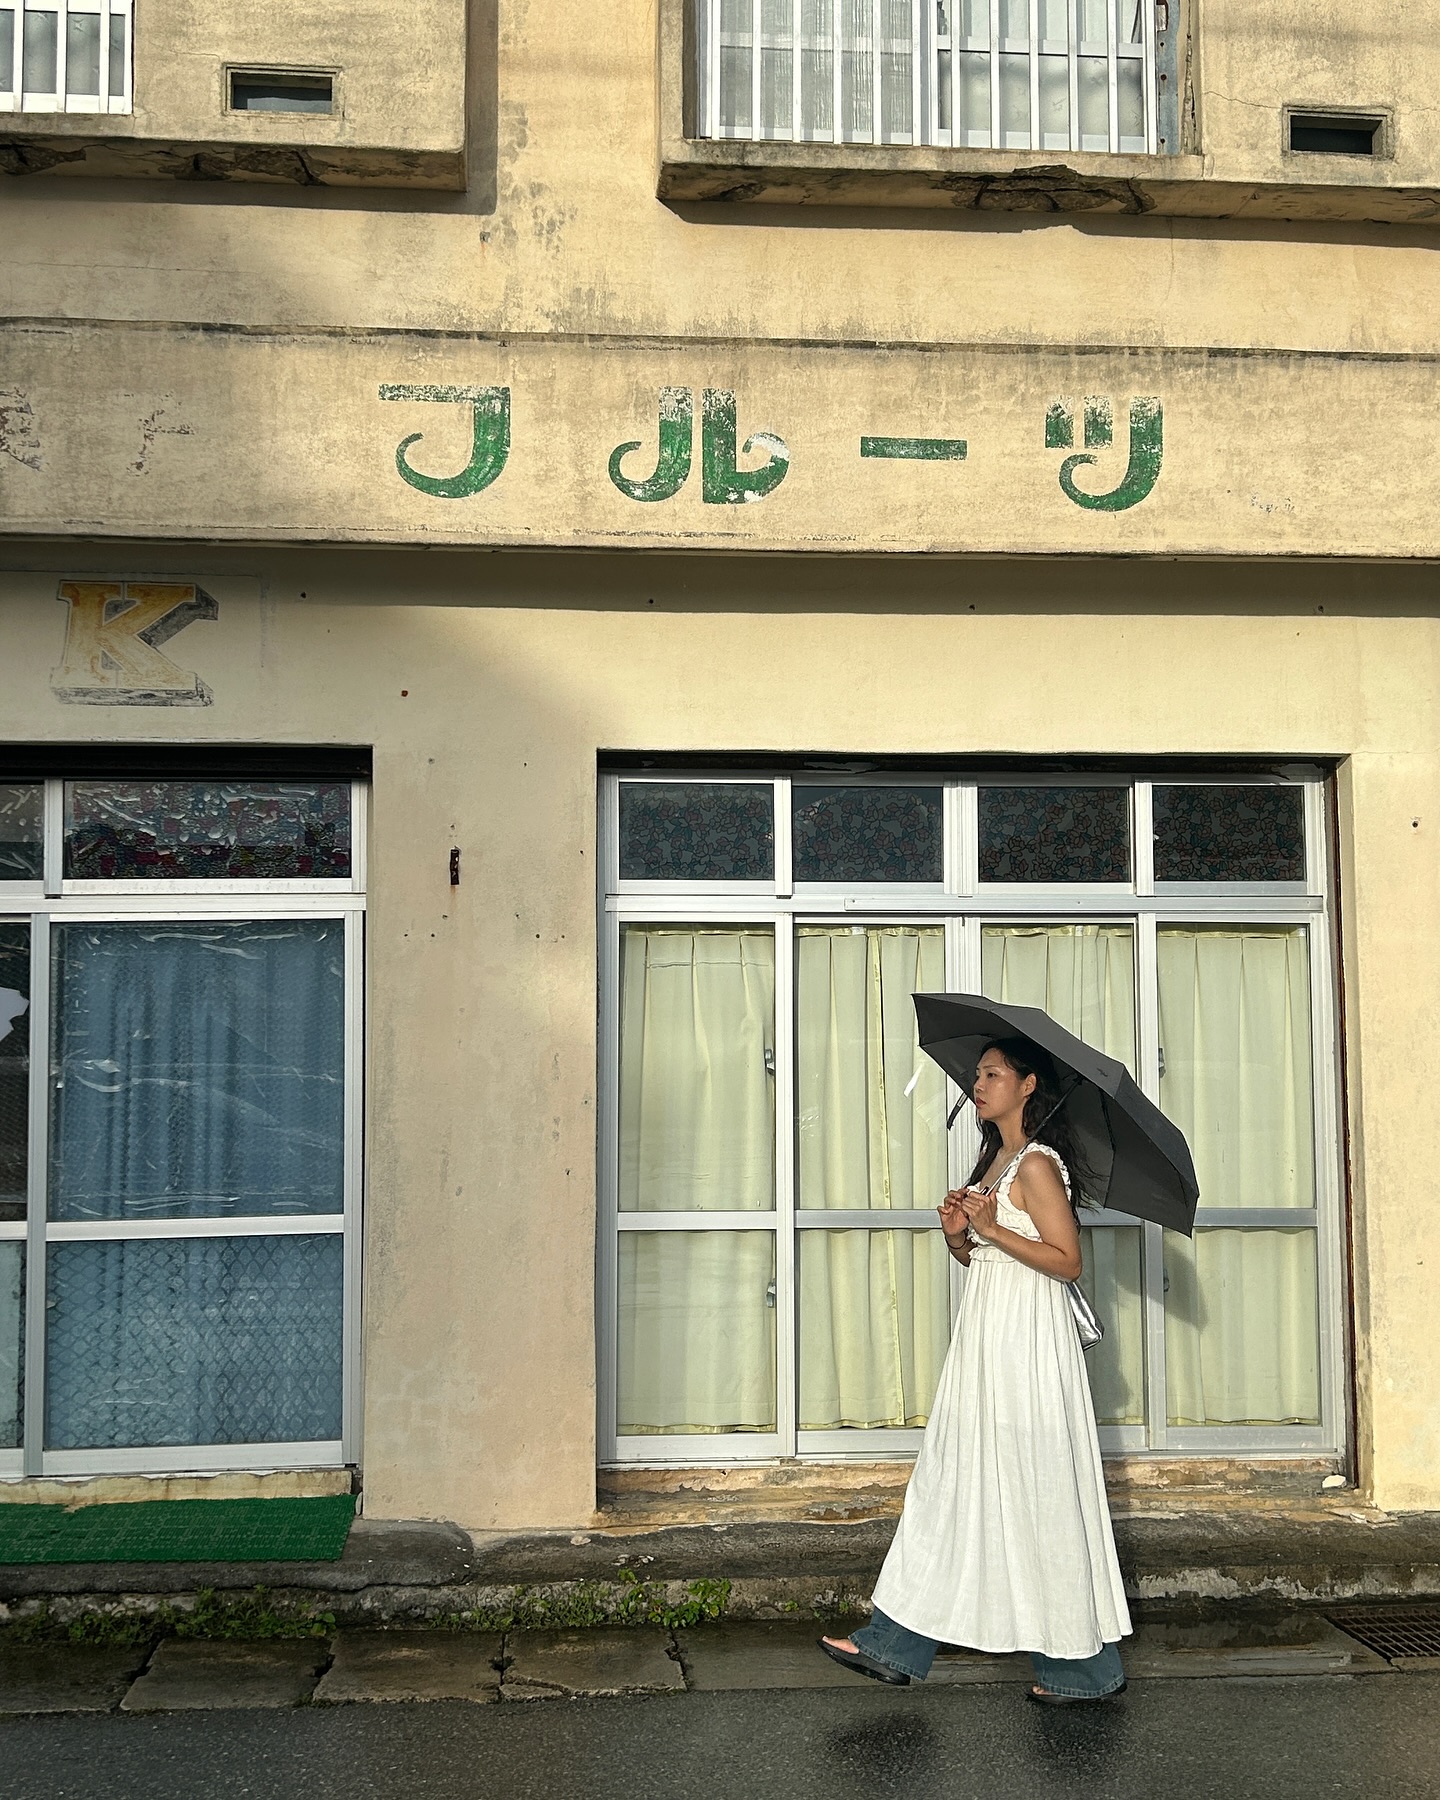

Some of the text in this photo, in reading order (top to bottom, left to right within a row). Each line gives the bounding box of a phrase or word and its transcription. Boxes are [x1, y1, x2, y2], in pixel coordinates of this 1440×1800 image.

[378, 384, 1163, 510] フルーツ
[51, 580, 218, 706] K
